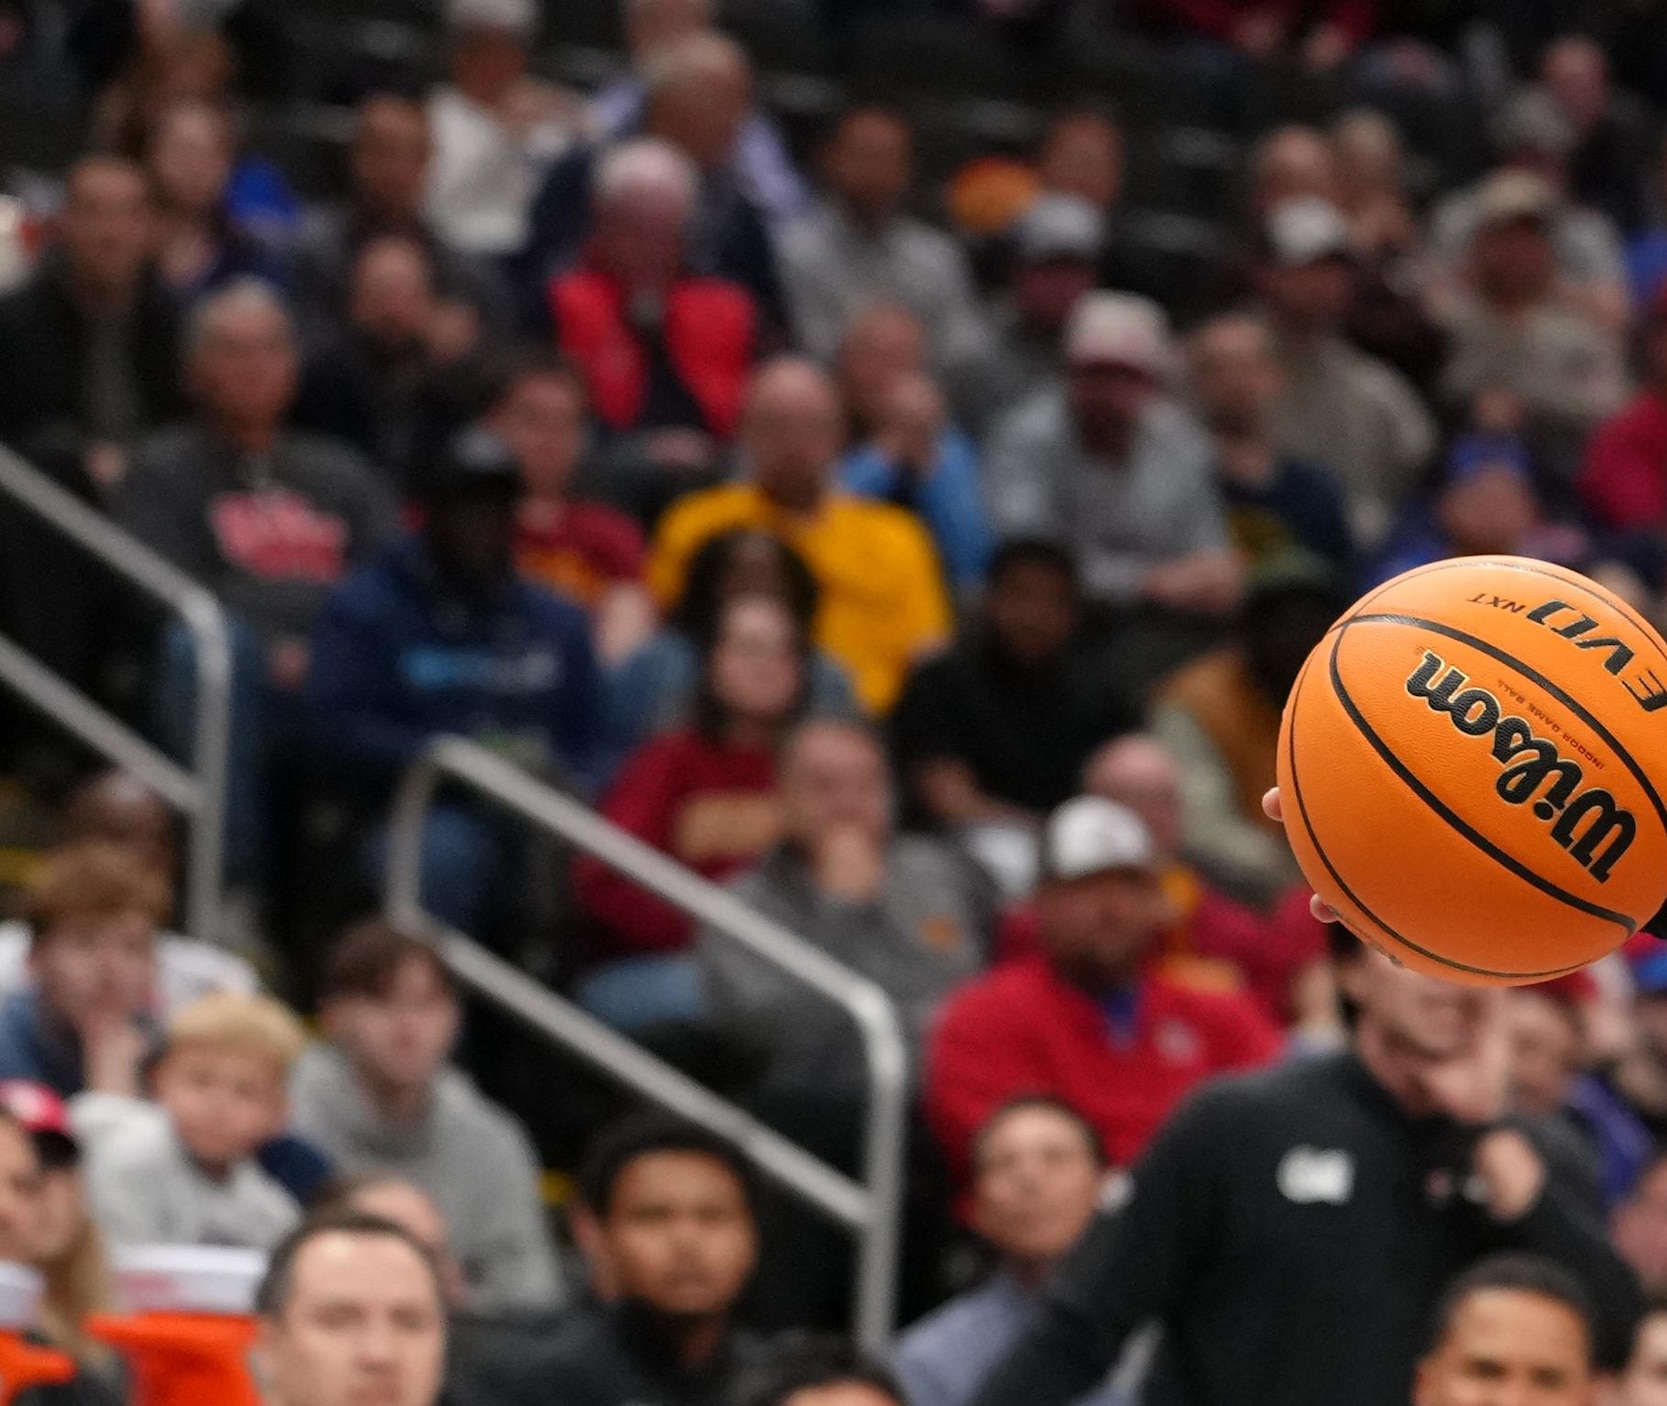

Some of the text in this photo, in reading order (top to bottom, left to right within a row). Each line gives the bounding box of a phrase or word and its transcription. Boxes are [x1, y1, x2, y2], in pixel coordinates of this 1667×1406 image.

[1466, 592, 1526, 615] NXT
[1406, 649, 1638, 885] Wilson
[1497, 678, 1605, 771] INDOOR GAME BALL
